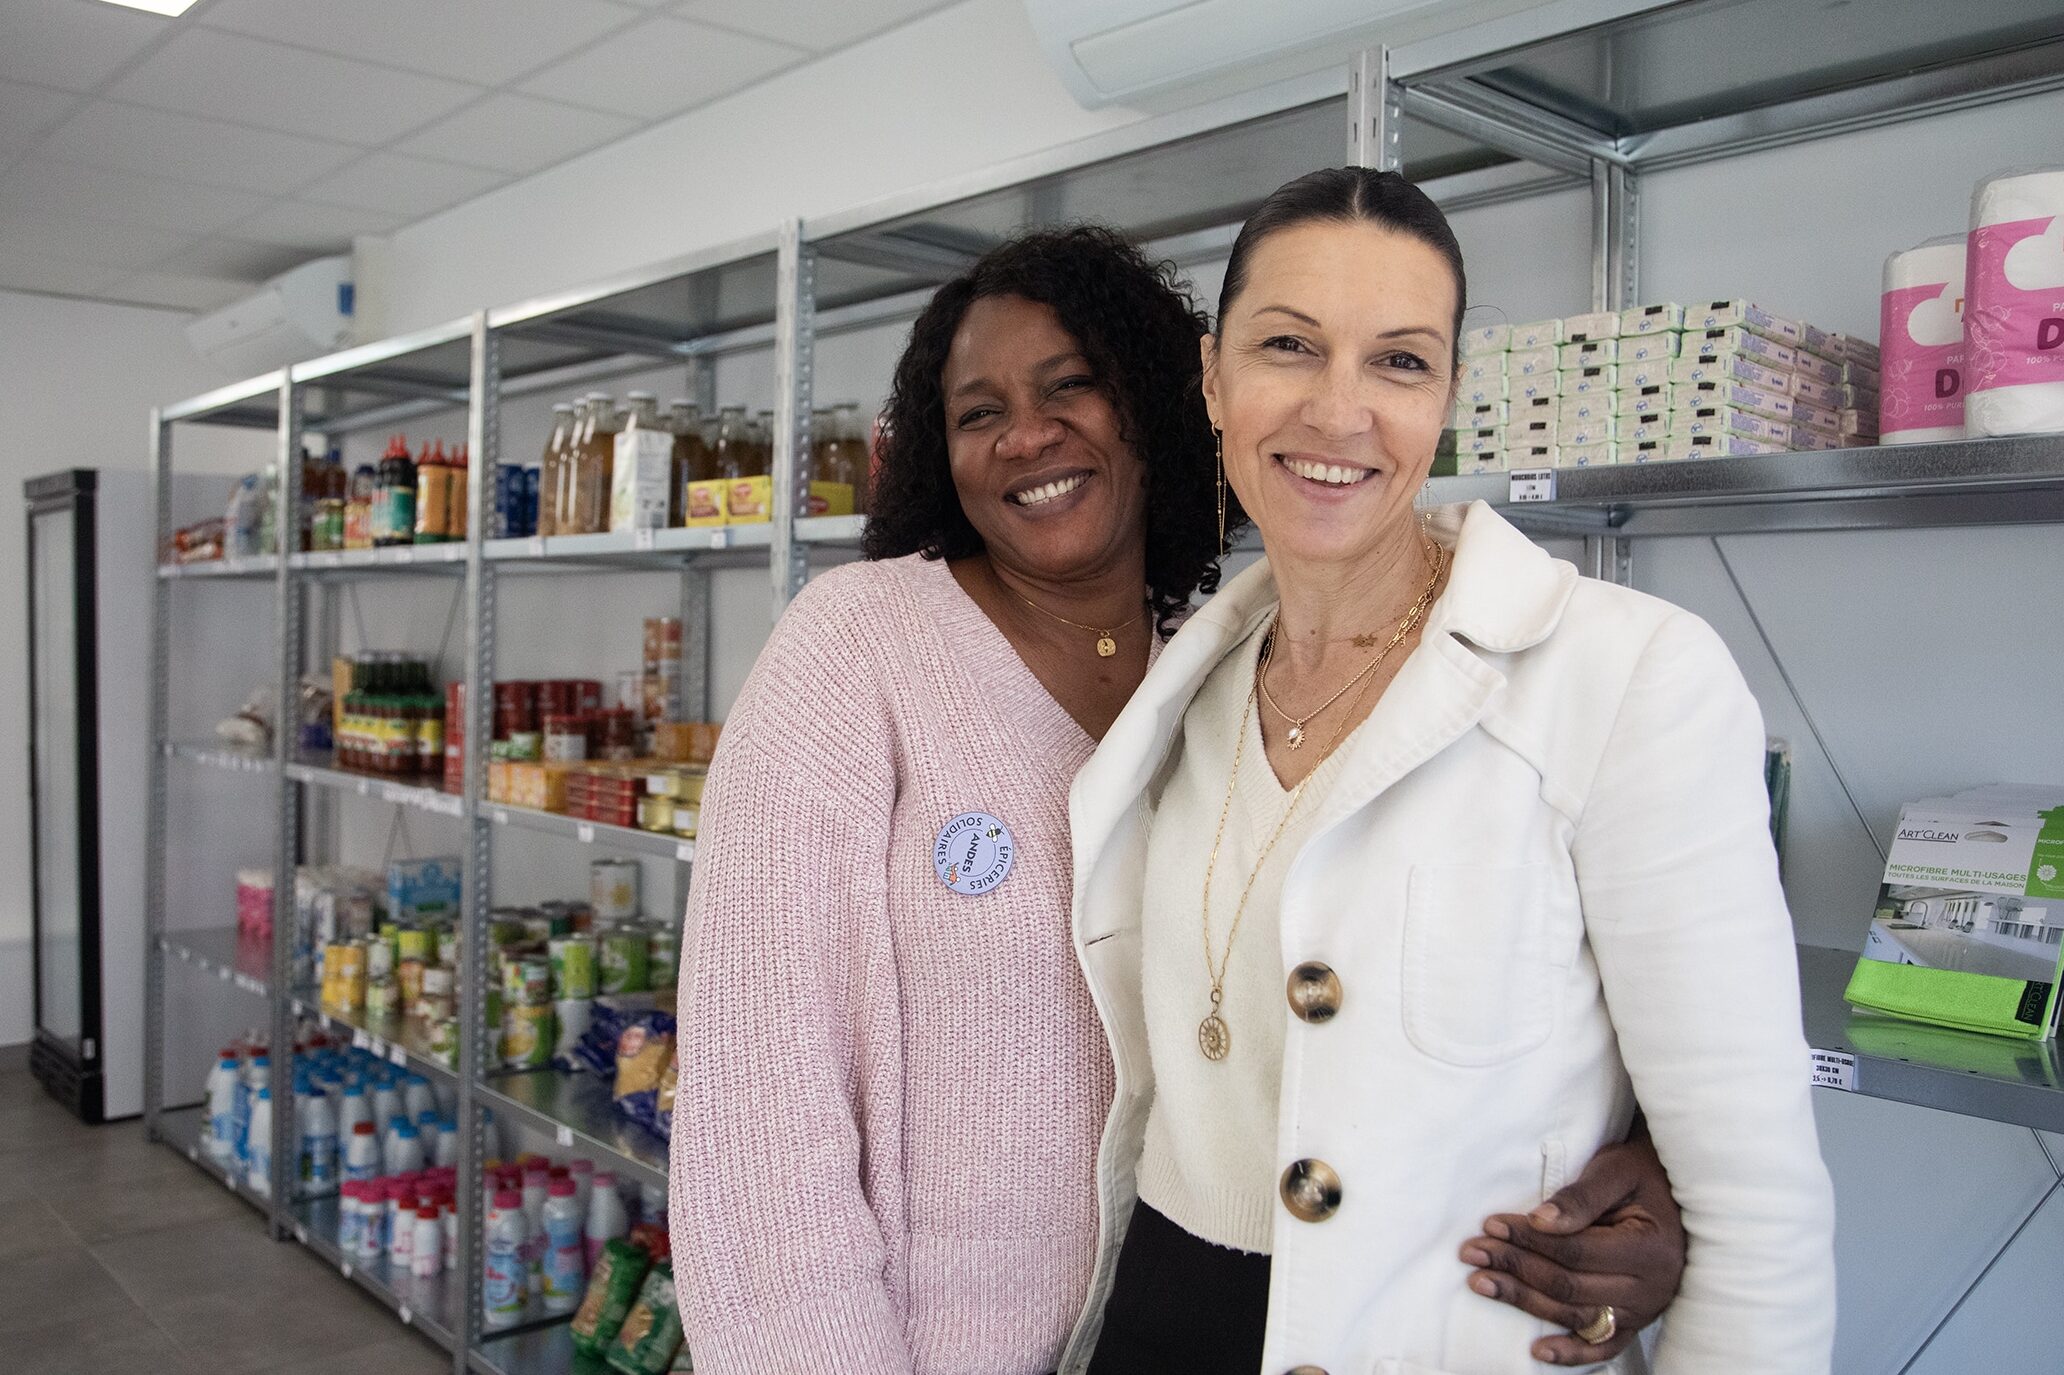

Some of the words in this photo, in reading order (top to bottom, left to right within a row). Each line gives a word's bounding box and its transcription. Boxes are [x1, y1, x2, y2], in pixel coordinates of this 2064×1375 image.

[1935, 369, 1963, 398] D
[938, 817, 983, 865] SOLIDAIRES
[1897, 828, 1959, 841] ART'CLEAN
[962, 833, 980, 873] ANDES
[969, 846, 1012, 890] ÉPICERIES
[1889, 863, 1949, 876] MICROFIBRE
[1950, 868, 2027, 882] MULTI-USAGES
[1930, 875, 1970, 884] SURFACES
[1994, 880, 2025, 889] MAISON
[2023, 981, 2045, 1021] RT'CLEAN
